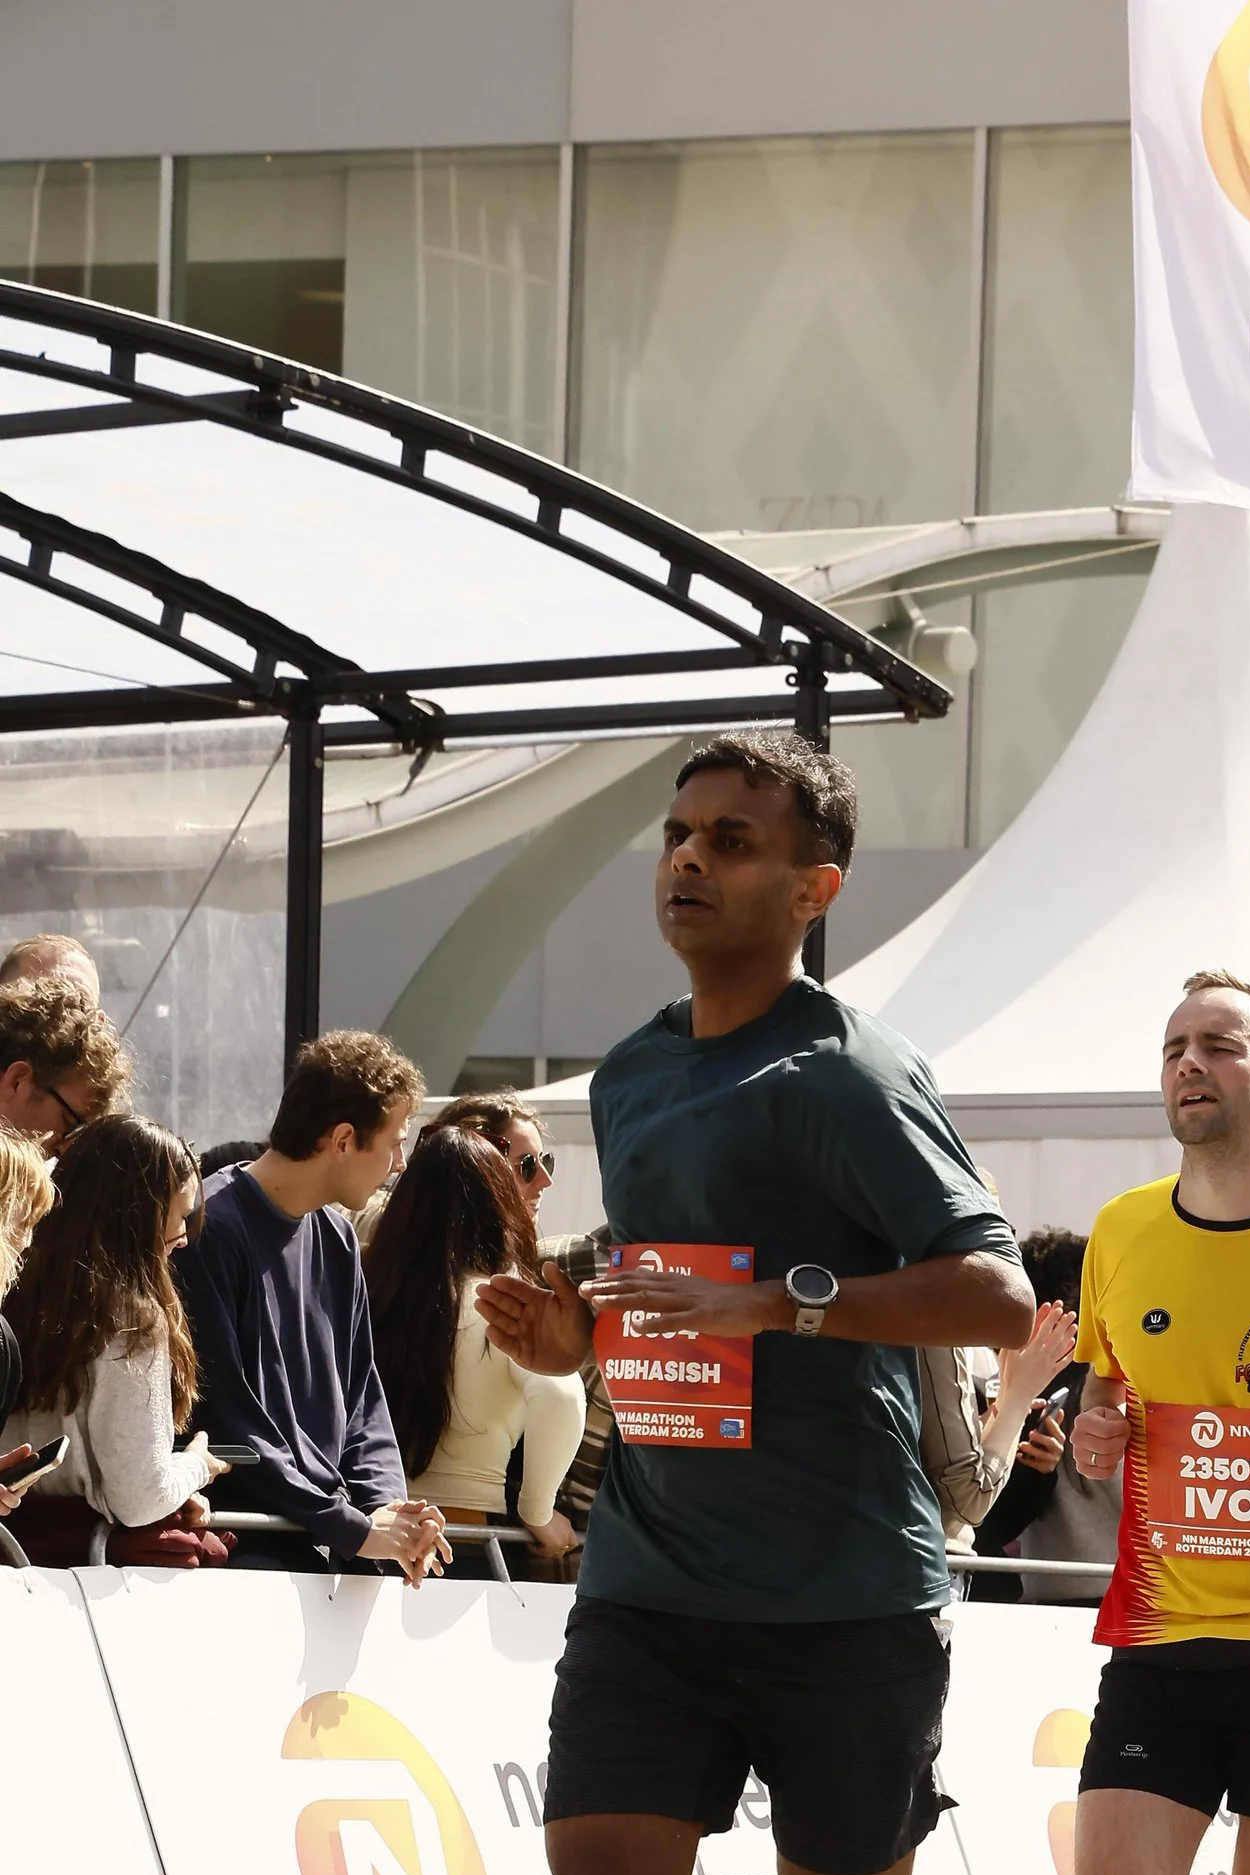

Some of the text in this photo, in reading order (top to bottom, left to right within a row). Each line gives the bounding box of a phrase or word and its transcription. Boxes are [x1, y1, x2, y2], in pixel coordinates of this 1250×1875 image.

[605, 1358, 721, 1384] SUBHASISH
[627, 1412, 695, 1426] MARATHON
[671, 1426, 704, 1439] 2026
[1182, 1534, 1198, 1544] NN
[1175, 1543, 1242, 1557] ROTTERDAM
